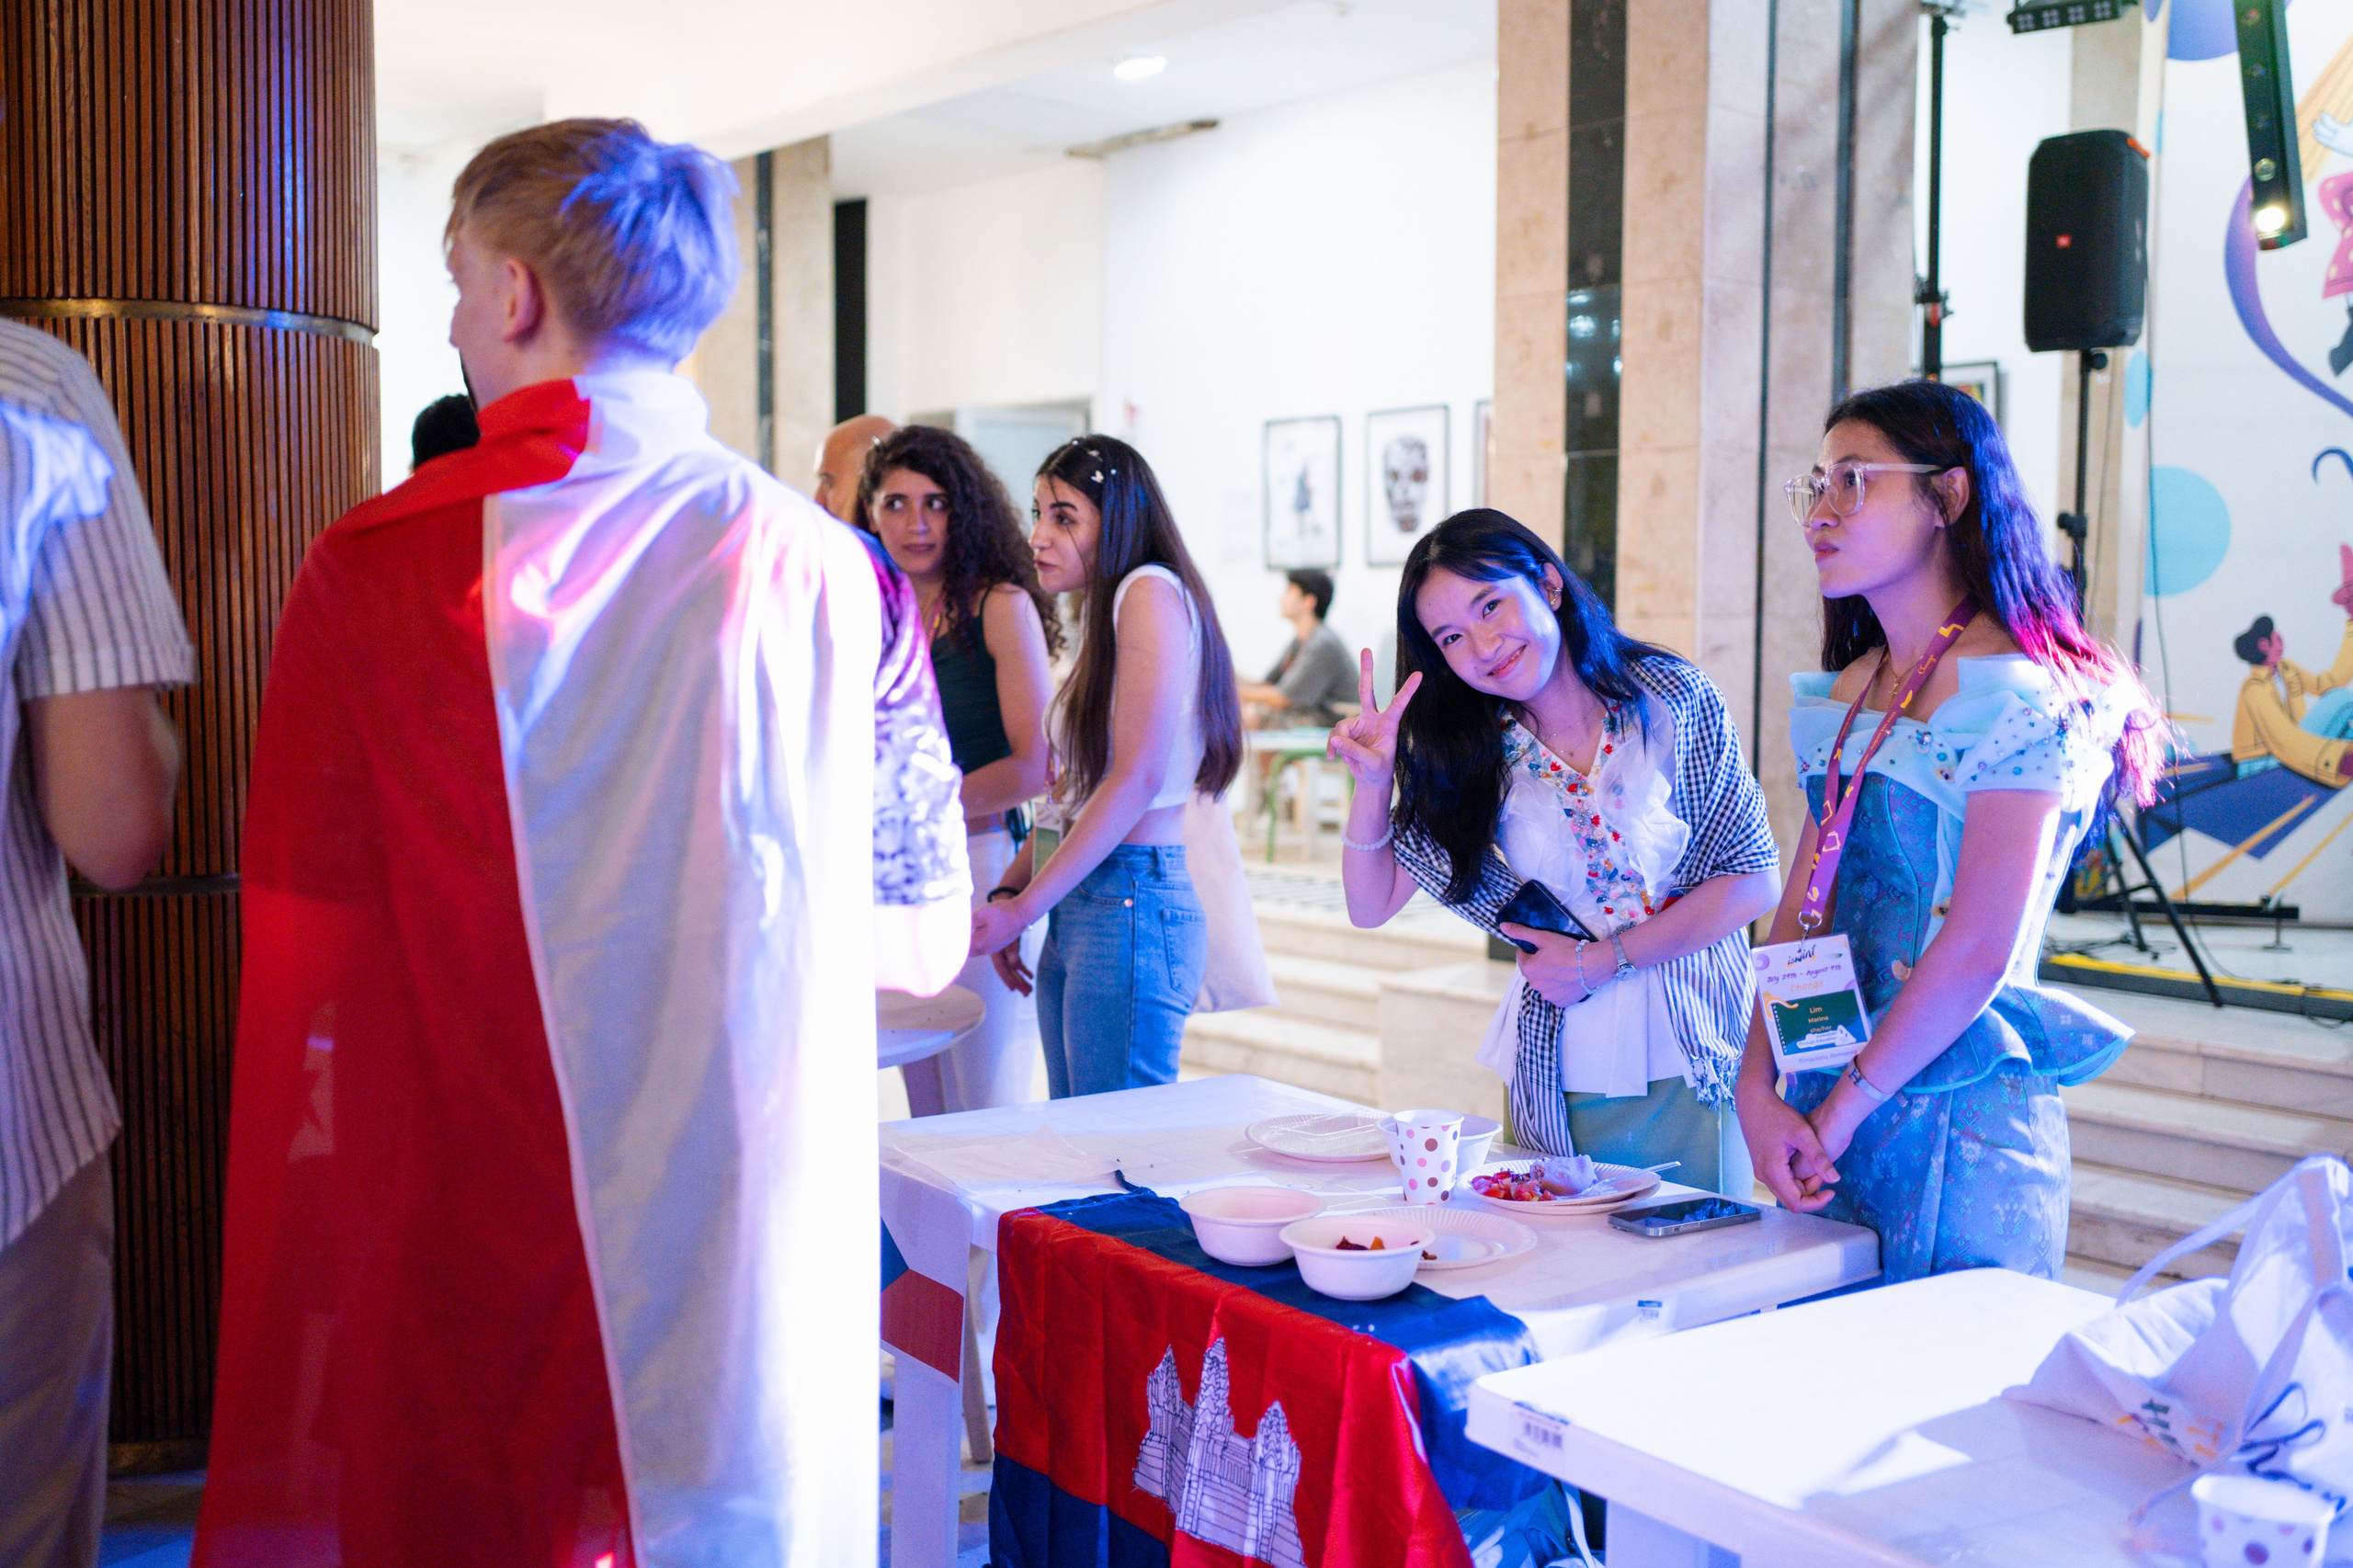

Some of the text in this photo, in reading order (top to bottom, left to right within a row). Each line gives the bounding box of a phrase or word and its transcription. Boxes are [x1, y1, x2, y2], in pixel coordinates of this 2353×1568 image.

[1767, 975, 1779, 985] July
[1806, 965, 1829, 979] August
[1790, 980, 1824, 995] Change
[1807, 1015, 1829, 1024] Marina
[1810, 1025, 1832, 1033] she/her
[1829, 1050, 1858, 1059] Romania
